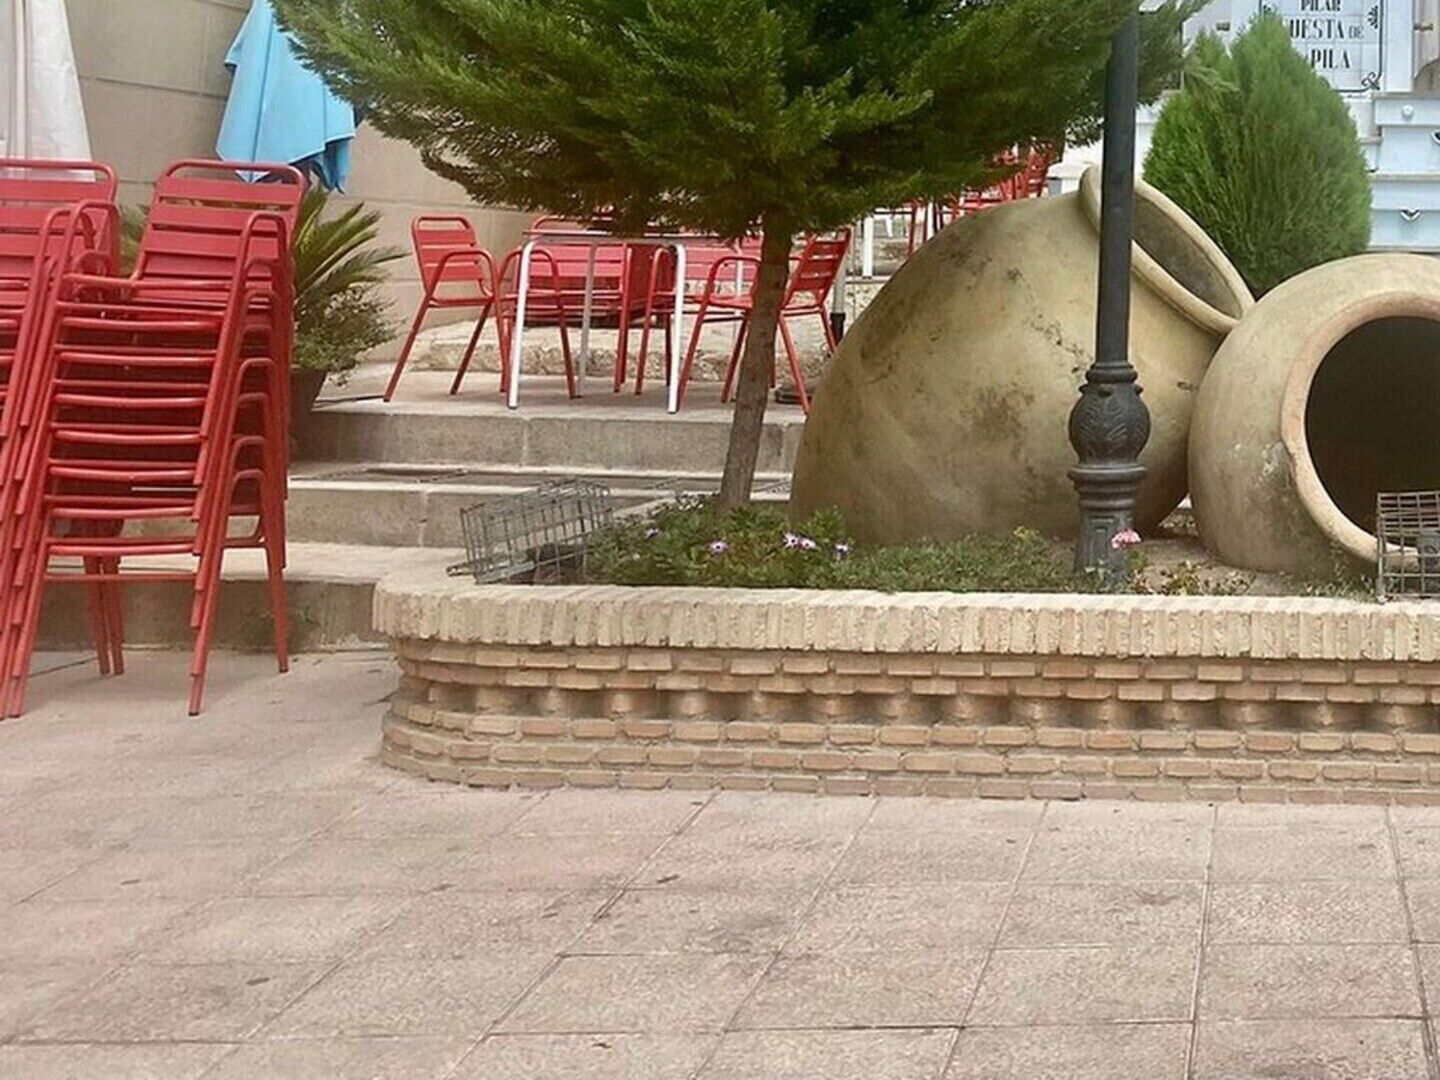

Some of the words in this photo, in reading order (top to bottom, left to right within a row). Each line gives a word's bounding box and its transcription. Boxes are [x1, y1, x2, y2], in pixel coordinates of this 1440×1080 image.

[1288, 18, 1345, 40] UESTA
[1348, 25, 1365, 39] DE
[1310, 48, 1351, 69] PILA
